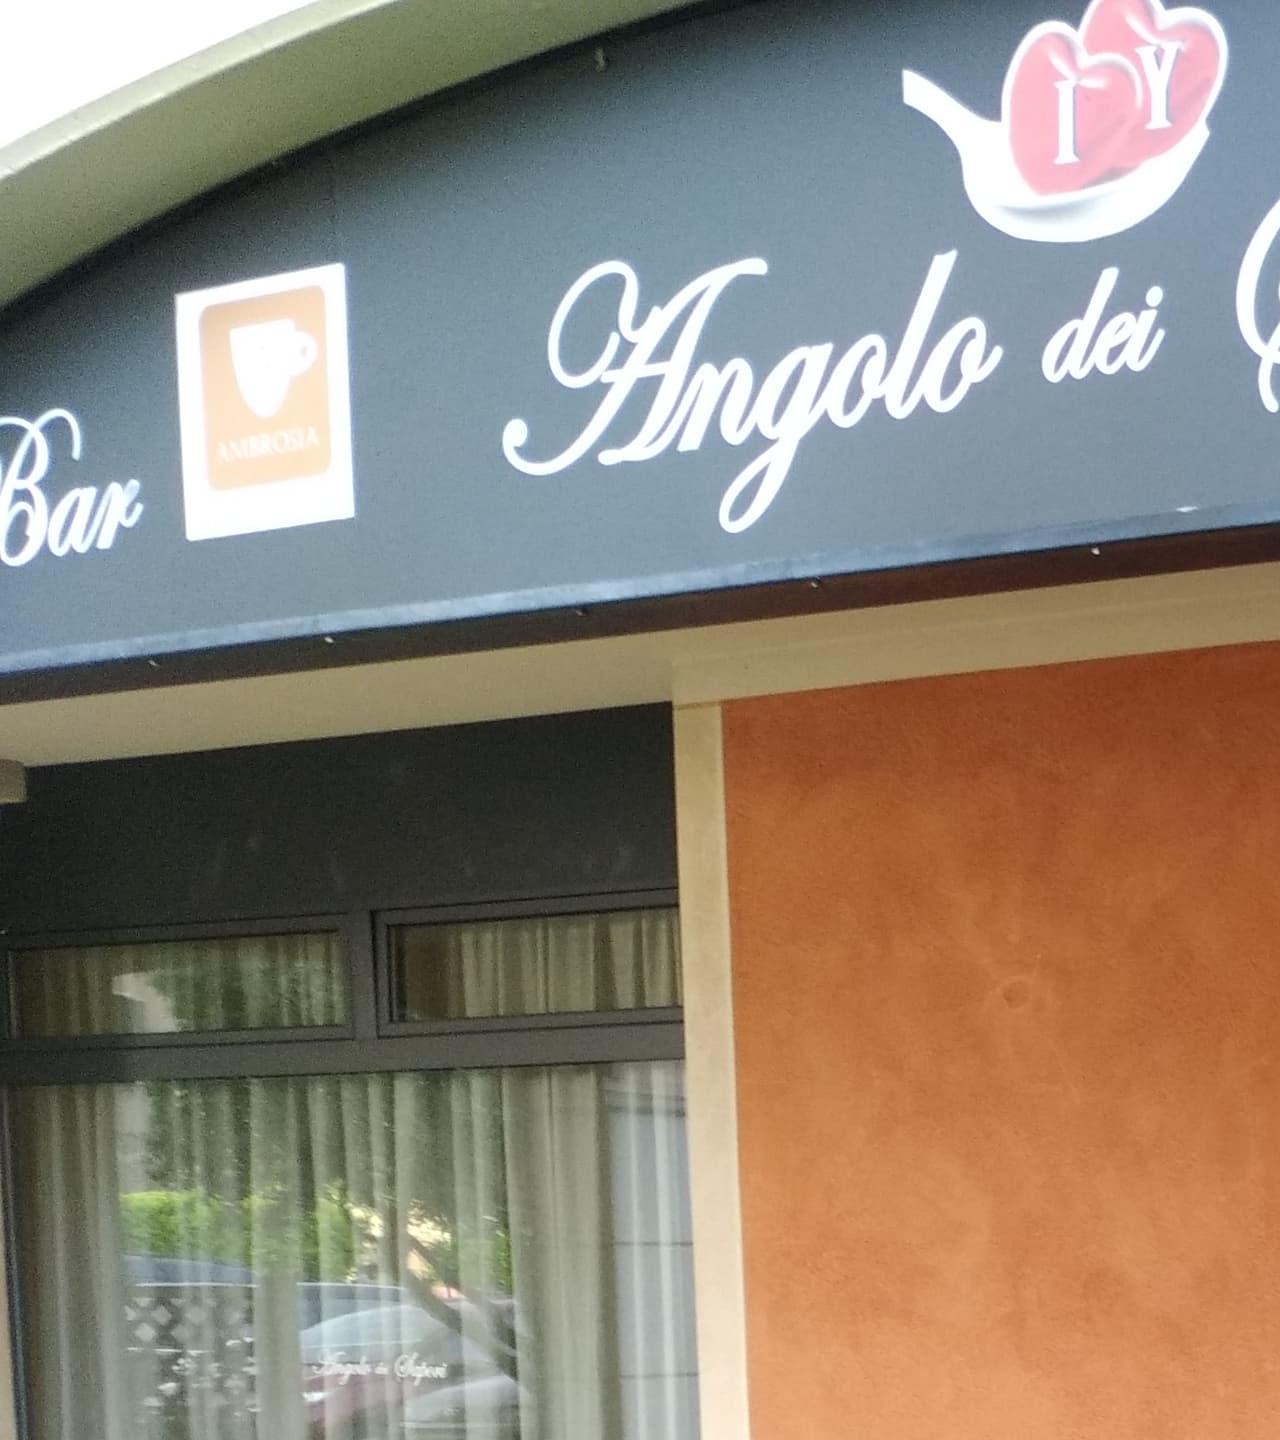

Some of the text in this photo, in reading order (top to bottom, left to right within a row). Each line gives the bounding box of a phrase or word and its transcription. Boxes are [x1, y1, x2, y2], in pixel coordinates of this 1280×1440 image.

[1135, 41, 1186, 130] Y
[216, 423, 320, 464] AMBROSIA
[502, 249, 1003, 534] Angolo
[1041, 266, 1165, 383] dei
[0, 408, 144, 567] Bar
